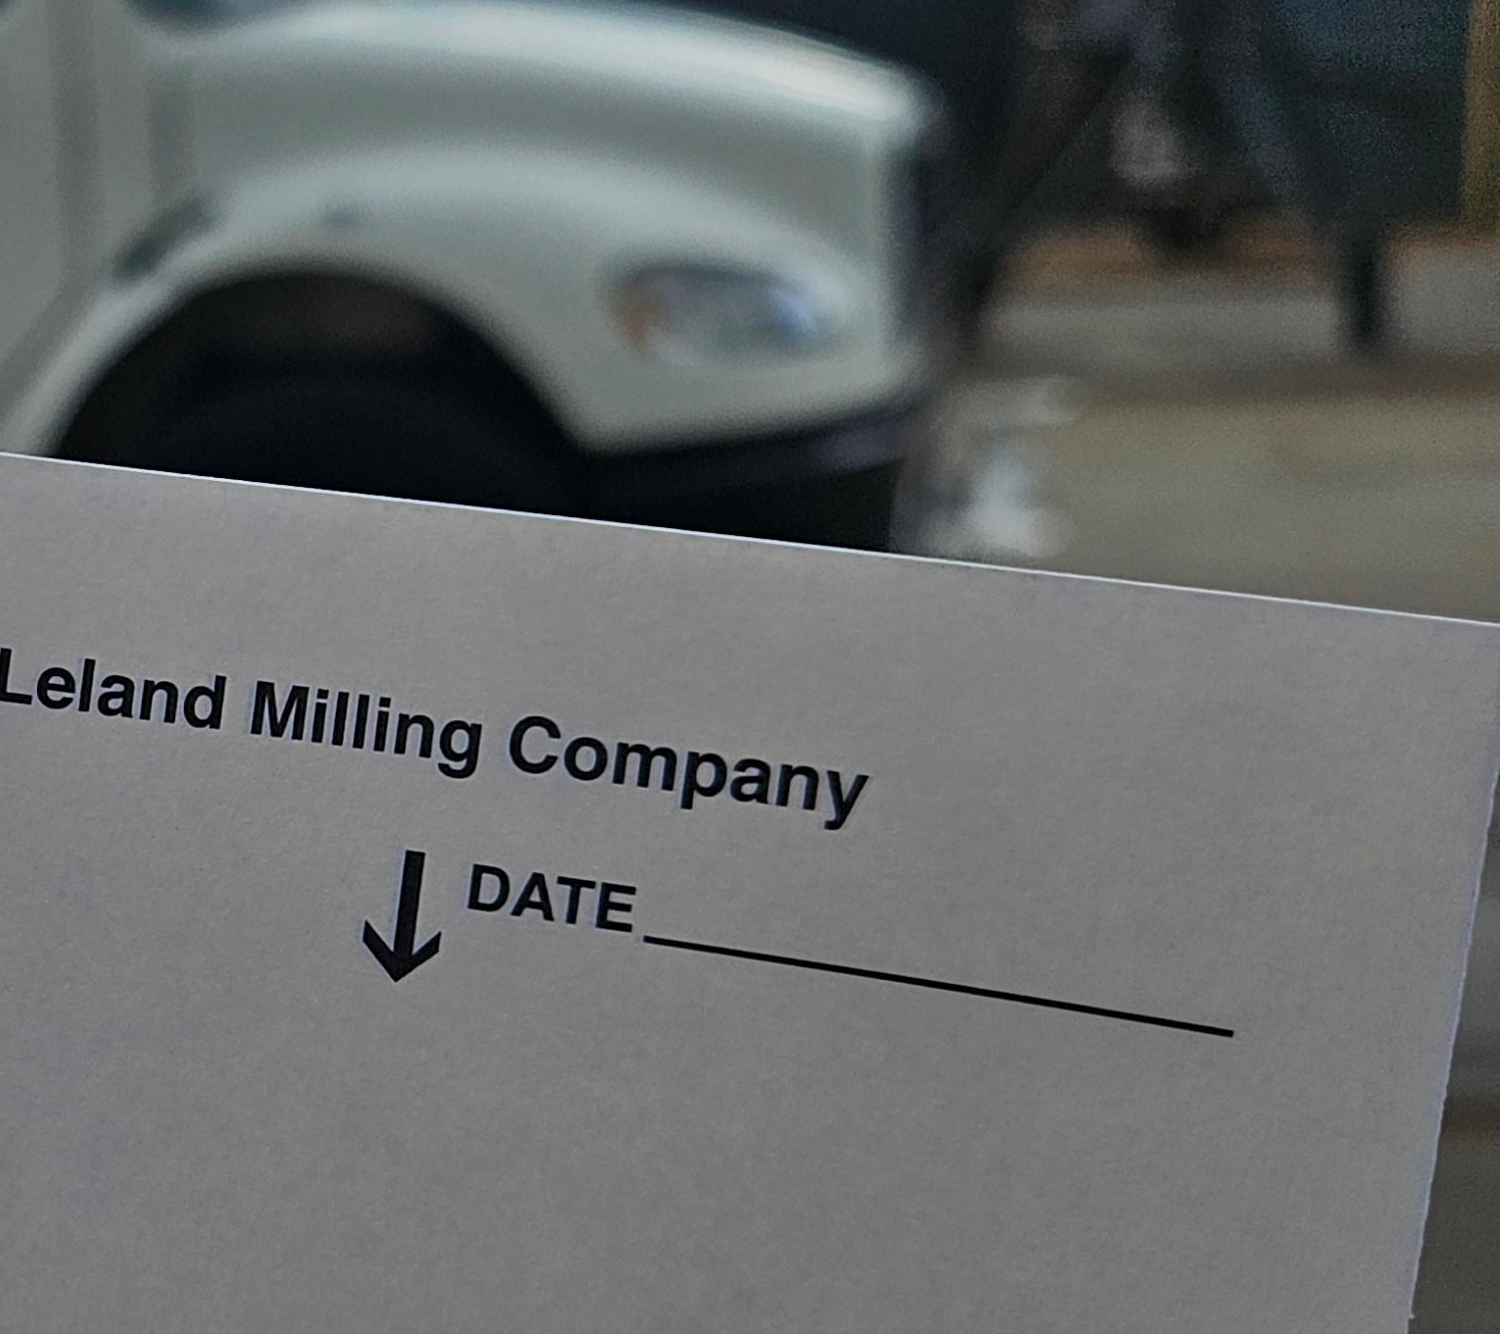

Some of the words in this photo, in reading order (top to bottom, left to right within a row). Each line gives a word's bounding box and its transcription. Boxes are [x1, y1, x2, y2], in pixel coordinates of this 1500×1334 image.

[250, 680, 483, 779] Milling
[509, 715, 870, 831] Company
[467, 864, 637, 933] DATE
